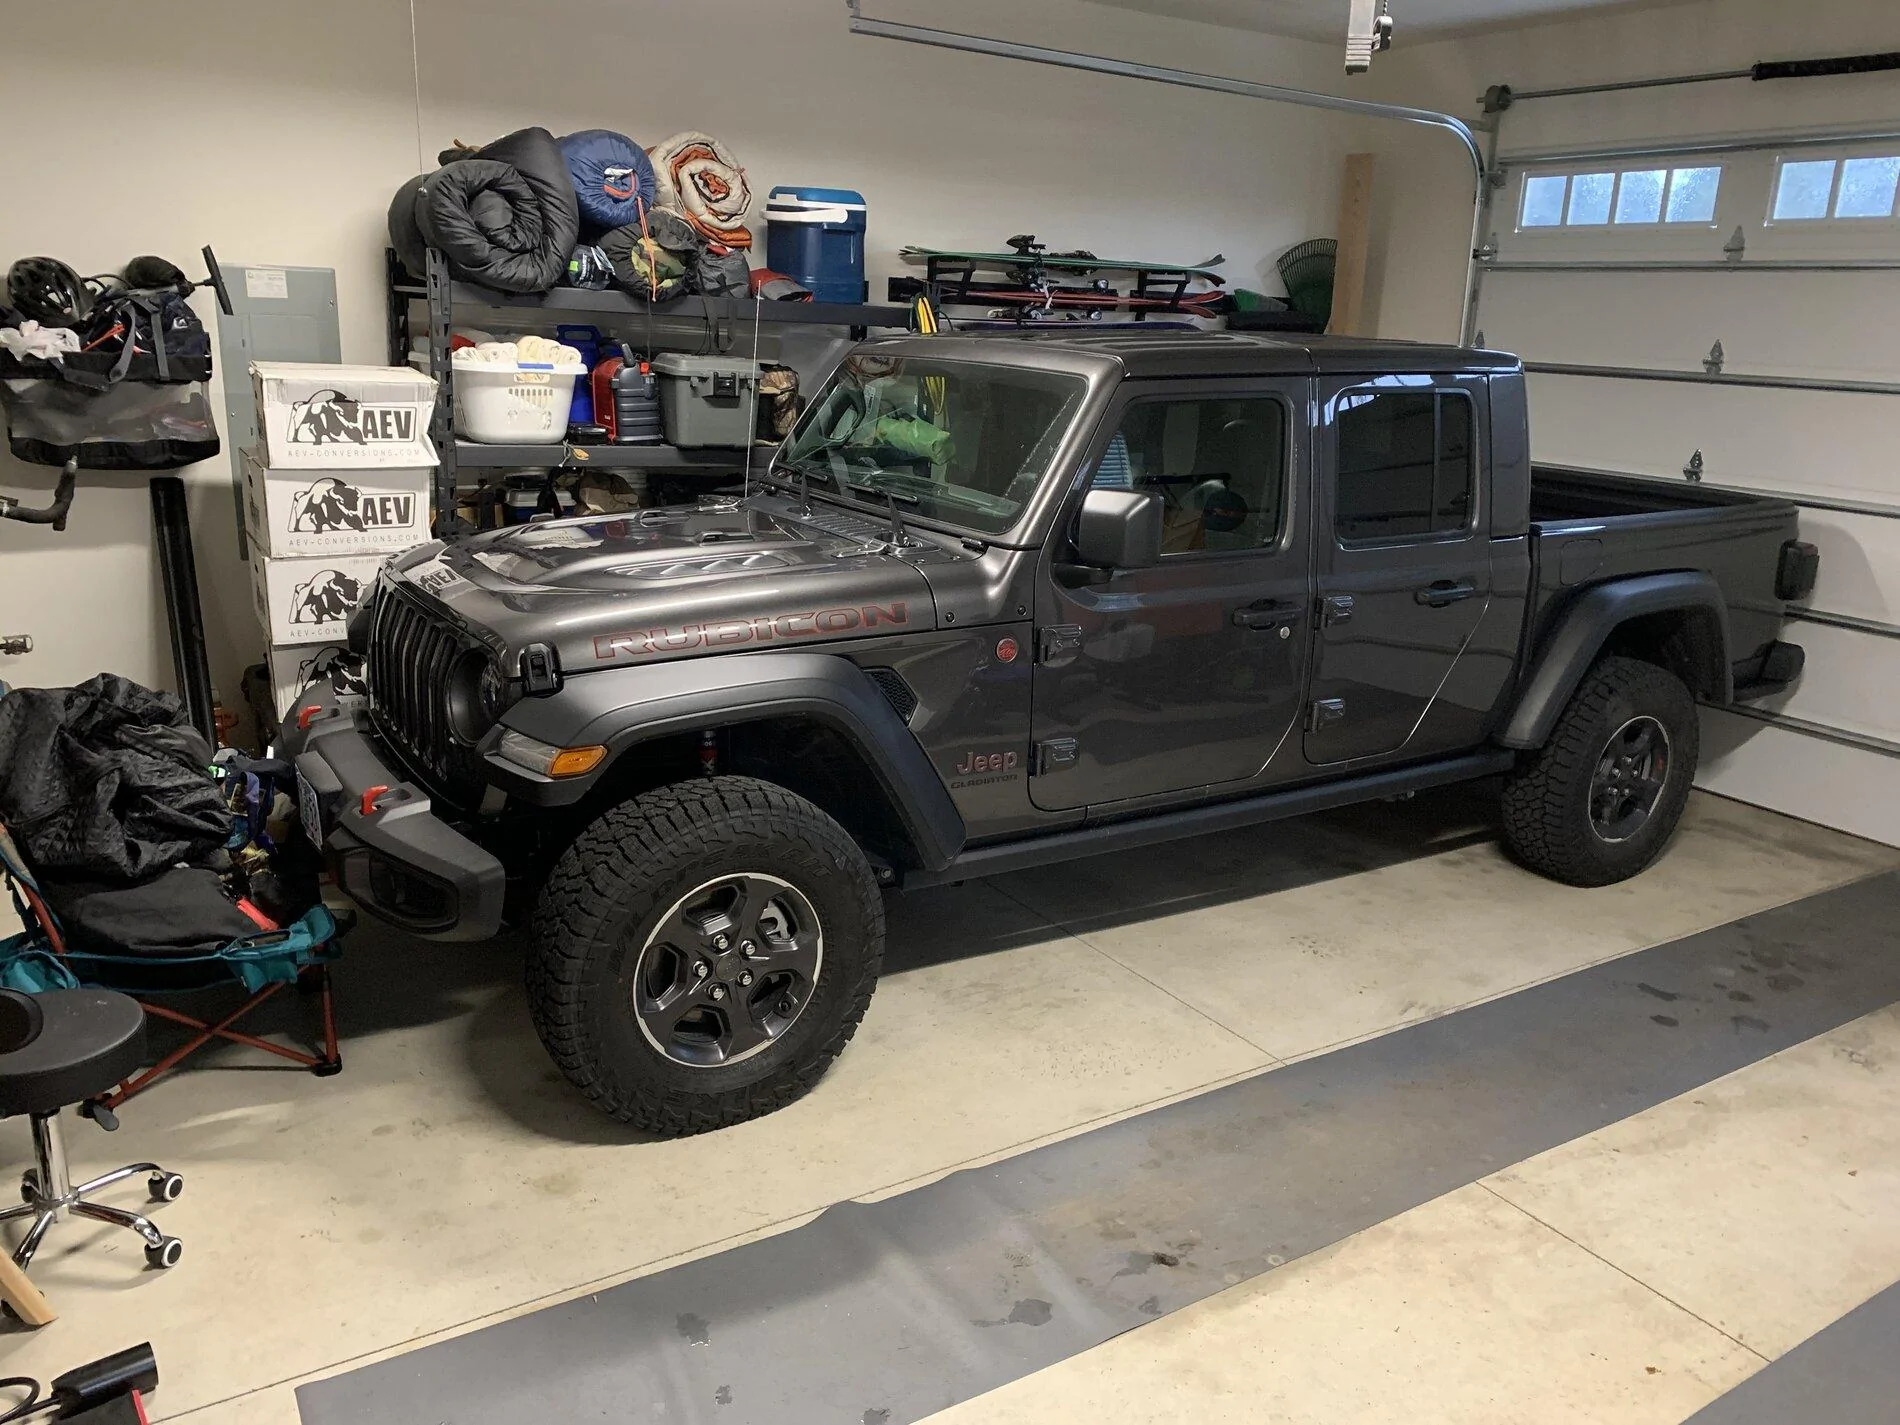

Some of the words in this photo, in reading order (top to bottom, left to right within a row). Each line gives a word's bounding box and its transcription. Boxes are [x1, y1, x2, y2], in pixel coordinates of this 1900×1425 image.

[362, 409, 412, 439] AEV
[288, 449, 420, 457] AEV-CONVERSIONS.COM
[362, 496, 411, 525] AEV
[289, 534, 419, 547] AEV-CONVERSIONS.COM
[290, 627, 345, 637] AEV-CONV
[592, 602, 908, 659] RUBICON
[955, 751, 1018, 776] Jeep
[950, 773, 1018, 789] GLADIATOR
